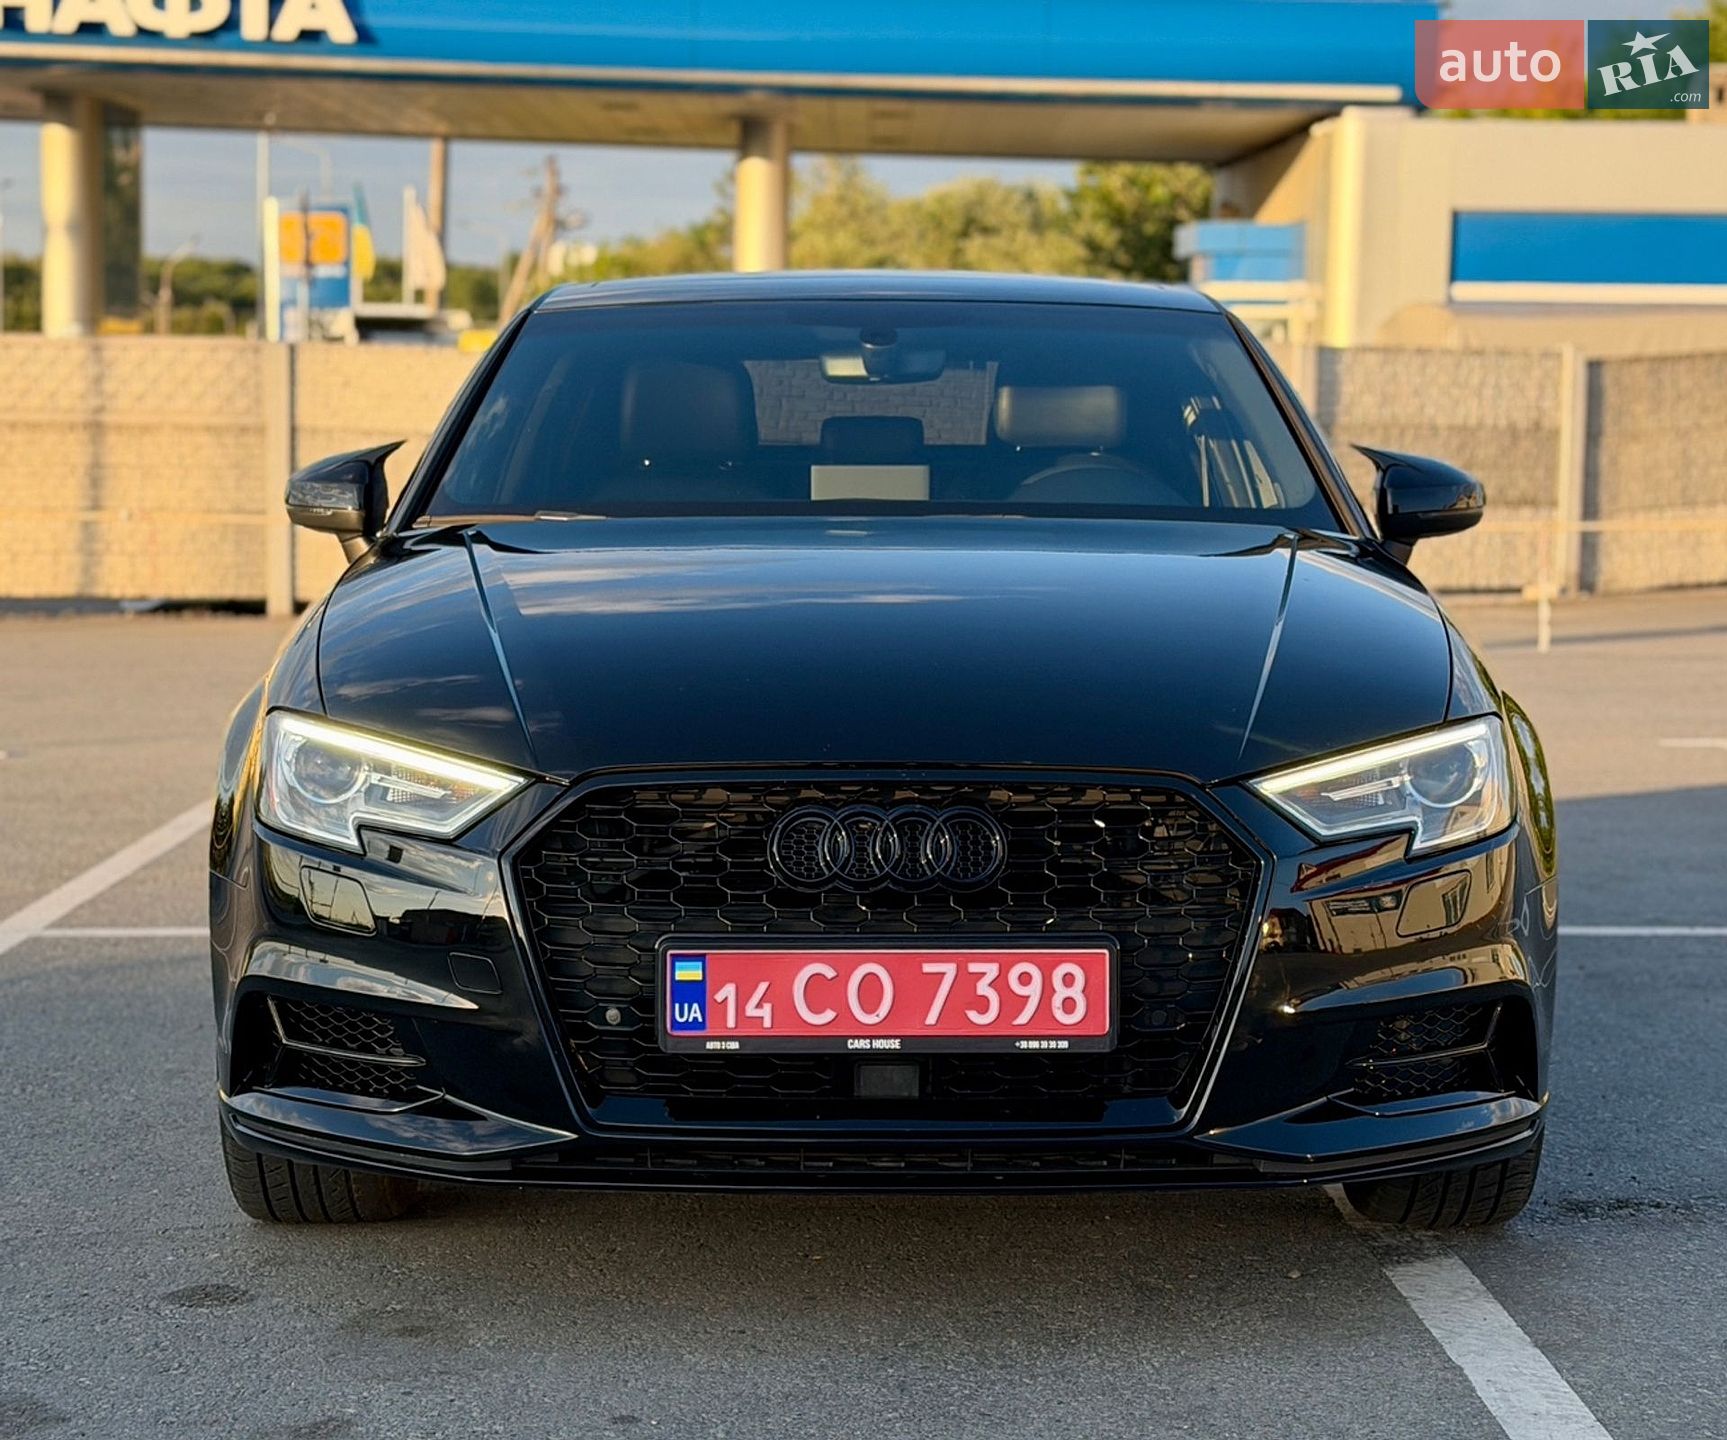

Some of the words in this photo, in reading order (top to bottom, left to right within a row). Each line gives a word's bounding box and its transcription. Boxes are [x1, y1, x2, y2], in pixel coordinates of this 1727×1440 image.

[713, 981, 772, 1029] 14
[792, 962, 895, 1026] CO
[921, 961, 1088, 1026] 7398
[674, 1002, 703, 1023] UA
[847, 1038, 871, 1050] CARS
[872, 1038, 902, 1050] HOUSE
